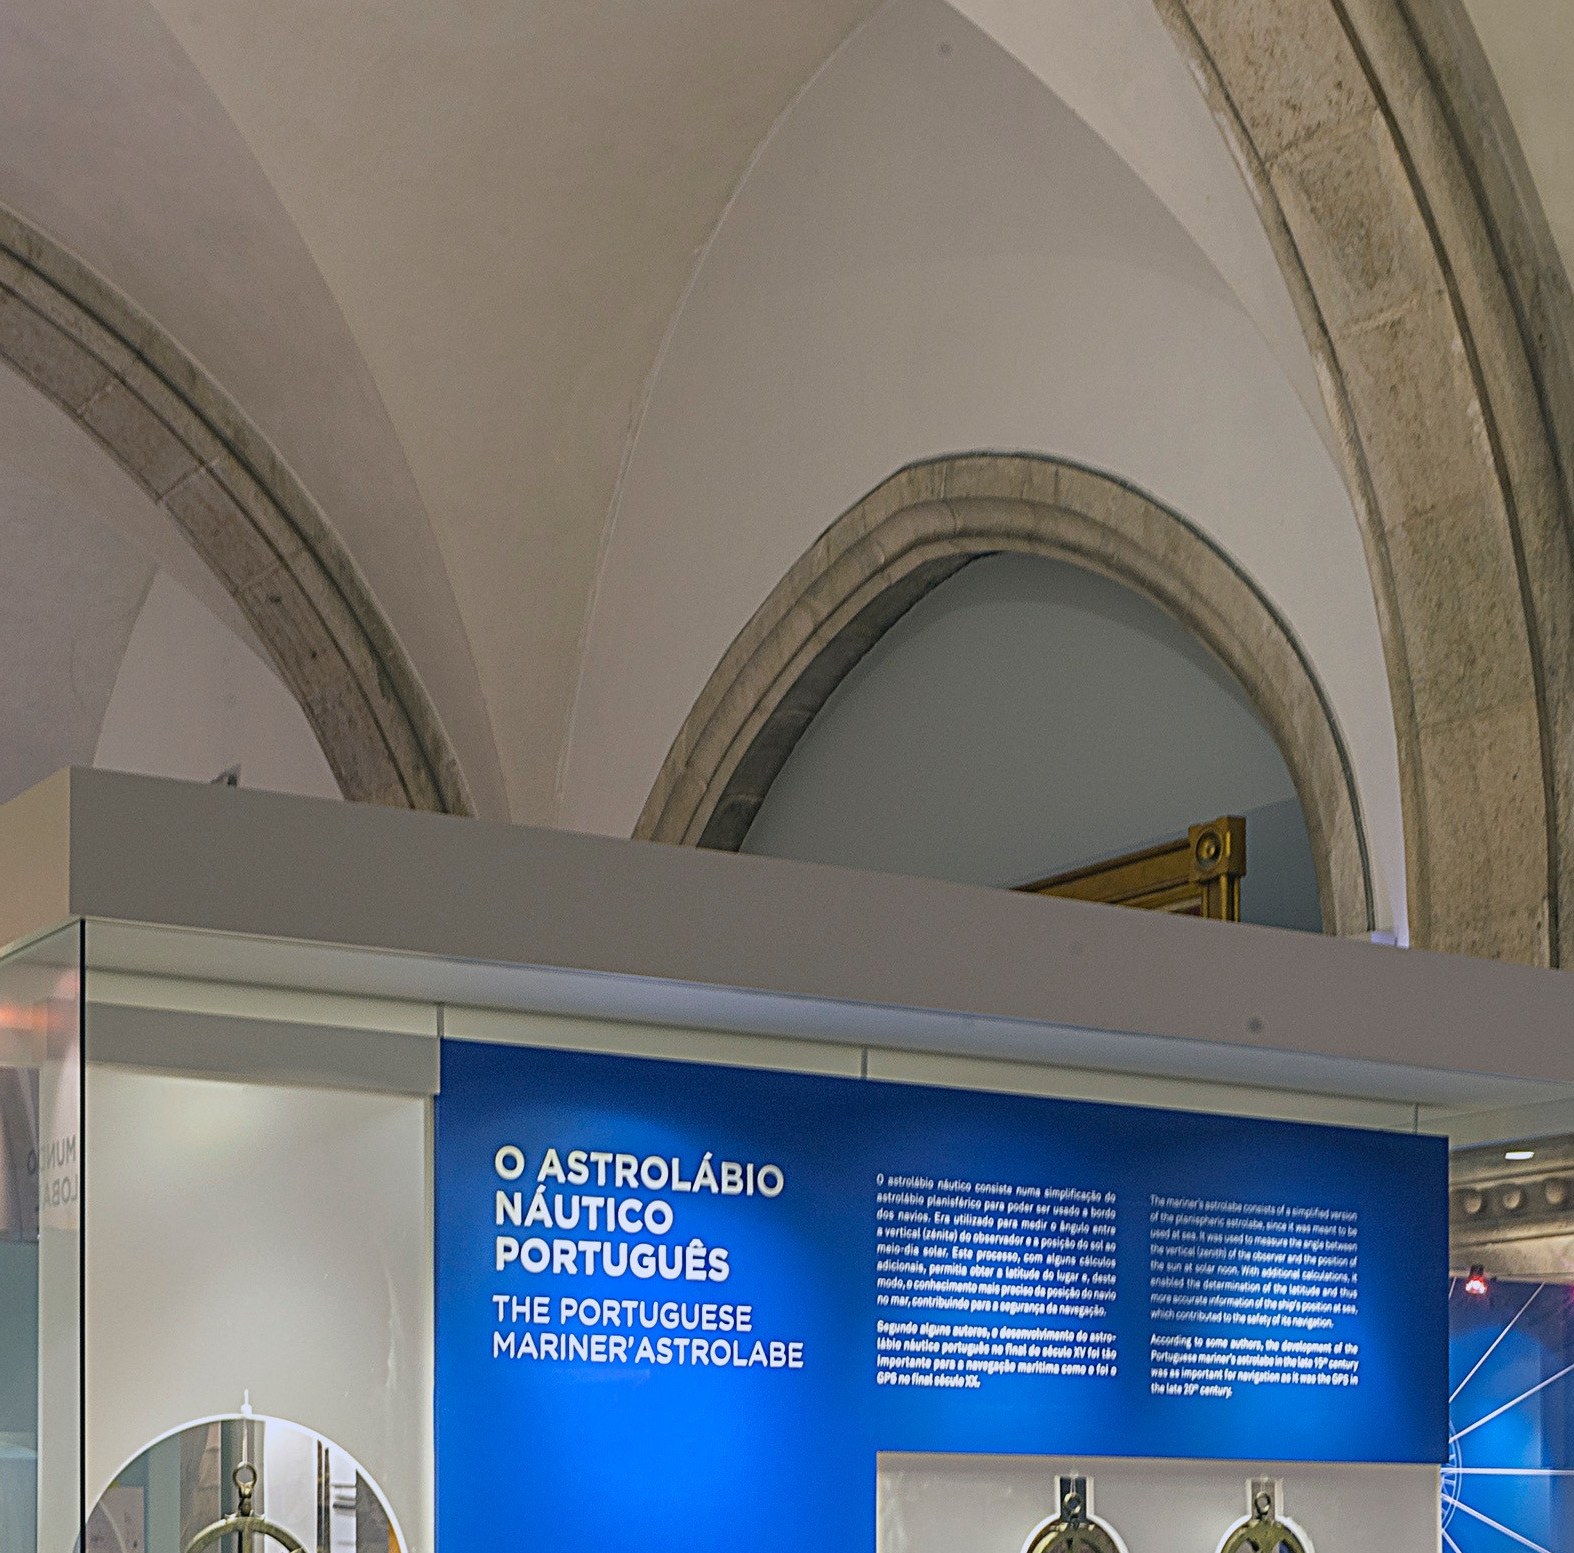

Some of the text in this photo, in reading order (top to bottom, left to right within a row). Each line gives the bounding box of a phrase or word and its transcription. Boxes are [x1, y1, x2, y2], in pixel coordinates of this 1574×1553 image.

[494, 1144, 785, 1197] O ASTROLÁBIO
[876, 1173, 883, 1185] O
[888, 1176, 933, 1188] astrolábio
[937, 1179, 971, 1191] náutico
[975, 1183, 1012, 1194] consiste
[1016, 1186, 1040, 1196] numa
[1104, 1192, 1115, 1202] do
[495, 1185, 674, 1236] NÁUTICO
[876, 1193, 923, 1204] astrolábio
[984, 1201, 1004, 1211] para
[1007, 1202, 1033, 1212] poder
[1036, 1204, 1050, 1213] ser
[1053, 1206, 1079, 1215] usado
[1082, 1208, 1087, 1216] a
[1090, 1207, 1115, 1218] bordo
[876, 1208, 893, 1219] dos
[934, 1211, 949, 1223] Era
[953, 1214, 993, 1226] utilizado
[997, 1218, 1017, 1229] para
[1021, 1219, 1047, 1229] medir
[1050, 1222, 1056, 1231] o
[1059, 1221, 1089, 1234] ângulo
[1092, 1225, 1115, 1234] entre
[495, 1236, 729, 1282] PORTUGUÊS
[877, 1244, 918, 1255] meio-dia
[952, 1246, 972, 1258] Este
[1023, 1253, 1042, 1262] com
[1046, 1254, 1075, 1266] alguns
[1079, 1256, 1115, 1266] cálculos
[929, 1263, 967, 1275] permitia
[969, 1265, 994, 1276] obter
[996, 1268, 1002, 1278] a
[1005, 1267, 1039, 1279] latitude
[1042, 1269, 1053, 1280] do
[1056, 1270, 1078, 1283] lugar
[1092, 1273, 1115, 1283] deste
[492, 1294, 752, 1331] THE PORTUGUESE
